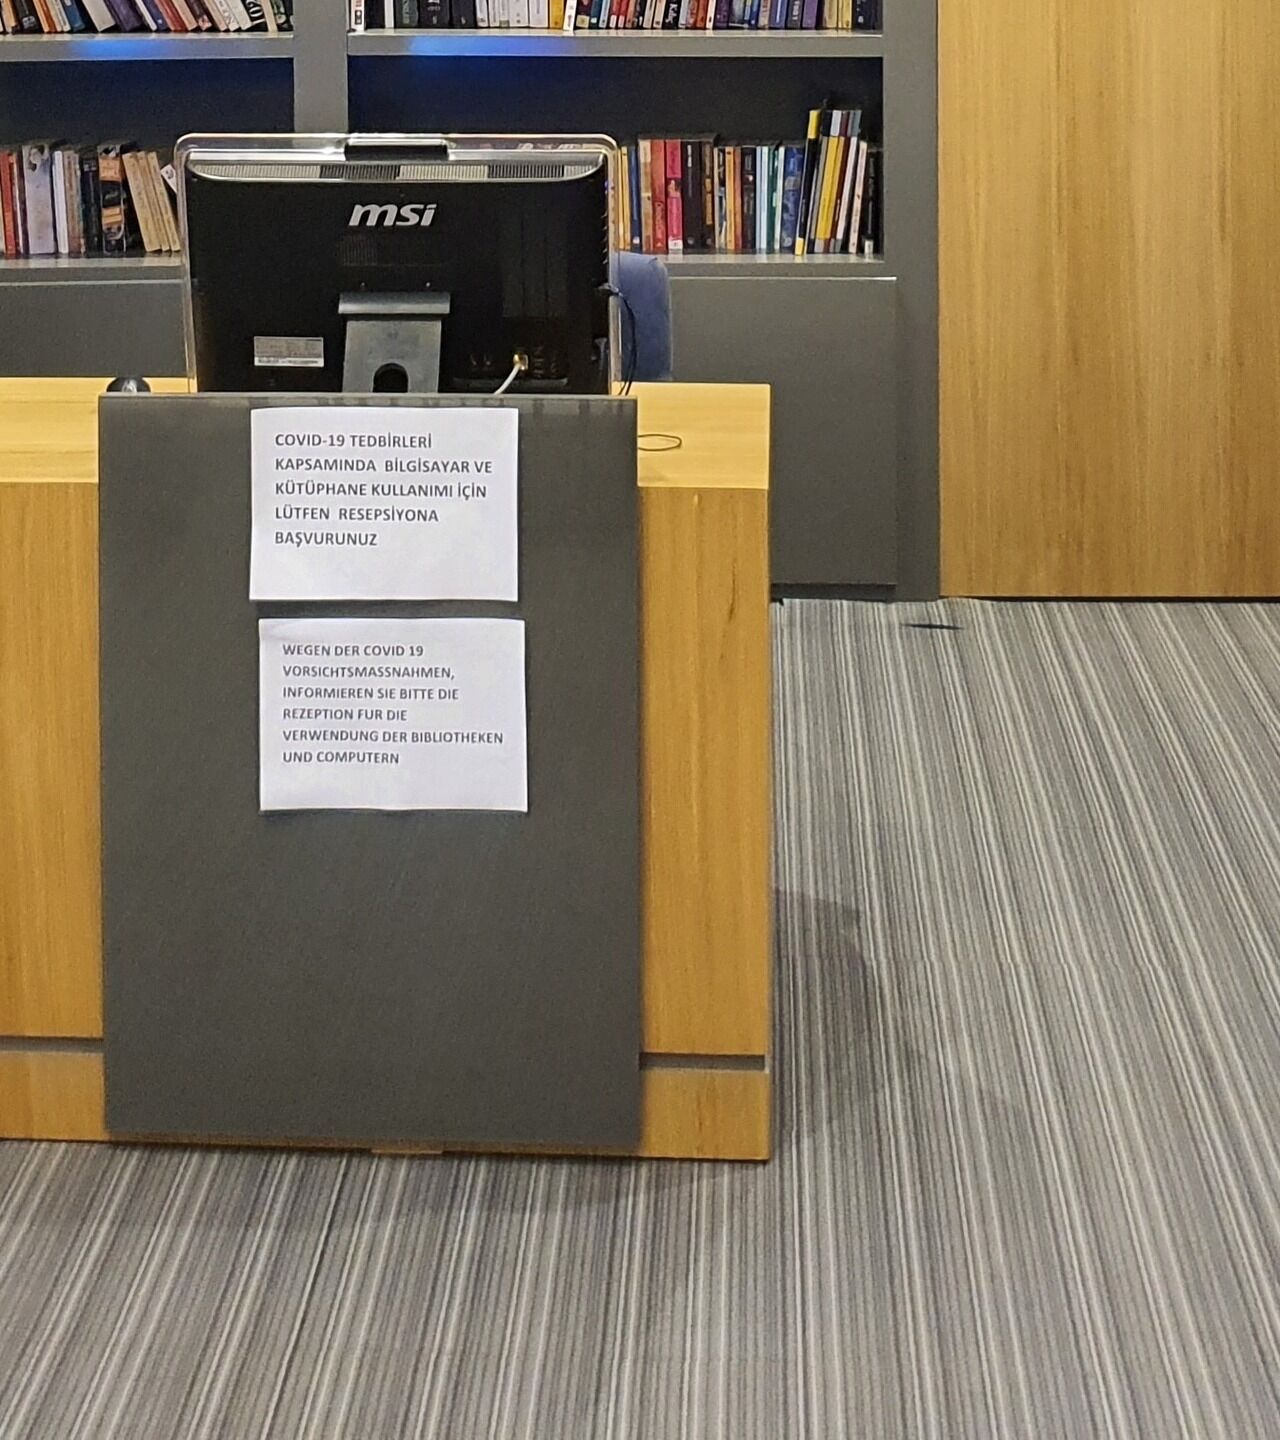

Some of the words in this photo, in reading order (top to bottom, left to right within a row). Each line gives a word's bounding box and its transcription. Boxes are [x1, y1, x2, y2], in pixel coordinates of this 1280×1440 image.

[348, 203, 438, 228] msi
[274, 433, 346, 448] COVID-19
[349, 431, 432, 449] TEDBİRLERİ
[275, 457, 377, 472] KAPSAMINDA
[384, 456, 470, 474] BİLGİSAYAR
[473, 460, 493, 474] VE
[275, 479, 367, 497] KÜTÜPHANE
[371, 483, 453, 498] KULLANIMI
[457, 481, 487, 501] İÇİN
[275, 503, 330, 521] LÜTFEN
[338, 505, 440, 522] RESEPSİYONA
[274, 531, 378, 549] BAŞVURUNUZ
[282, 643, 331, 657] WEGEN
[334, 645, 360, 657] DER
[363, 645, 405, 657] COVID
[409, 645, 424, 657] 19
[282, 665, 455, 681] VORSICHTSMASSNAHMEN,
[282, 686, 374, 700] INFORMIEREN
[377, 687, 396, 700] SIE
[399, 688, 434, 700] BITTE
[438, 688, 460, 701] DIE
[282, 707, 354, 721] REZEPTION
[357, 708, 383, 721] FUR
[386, 709, 408, 722] DIE
[282, 729, 379, 743] VERWENDUNG
[382, 730, 408, 743] DER
[411, 731, 504, 745] BIBLIOTHEKEN
[282, 751, 313, 764] UND
[316, 751, 400, 765] COMPUTERN
